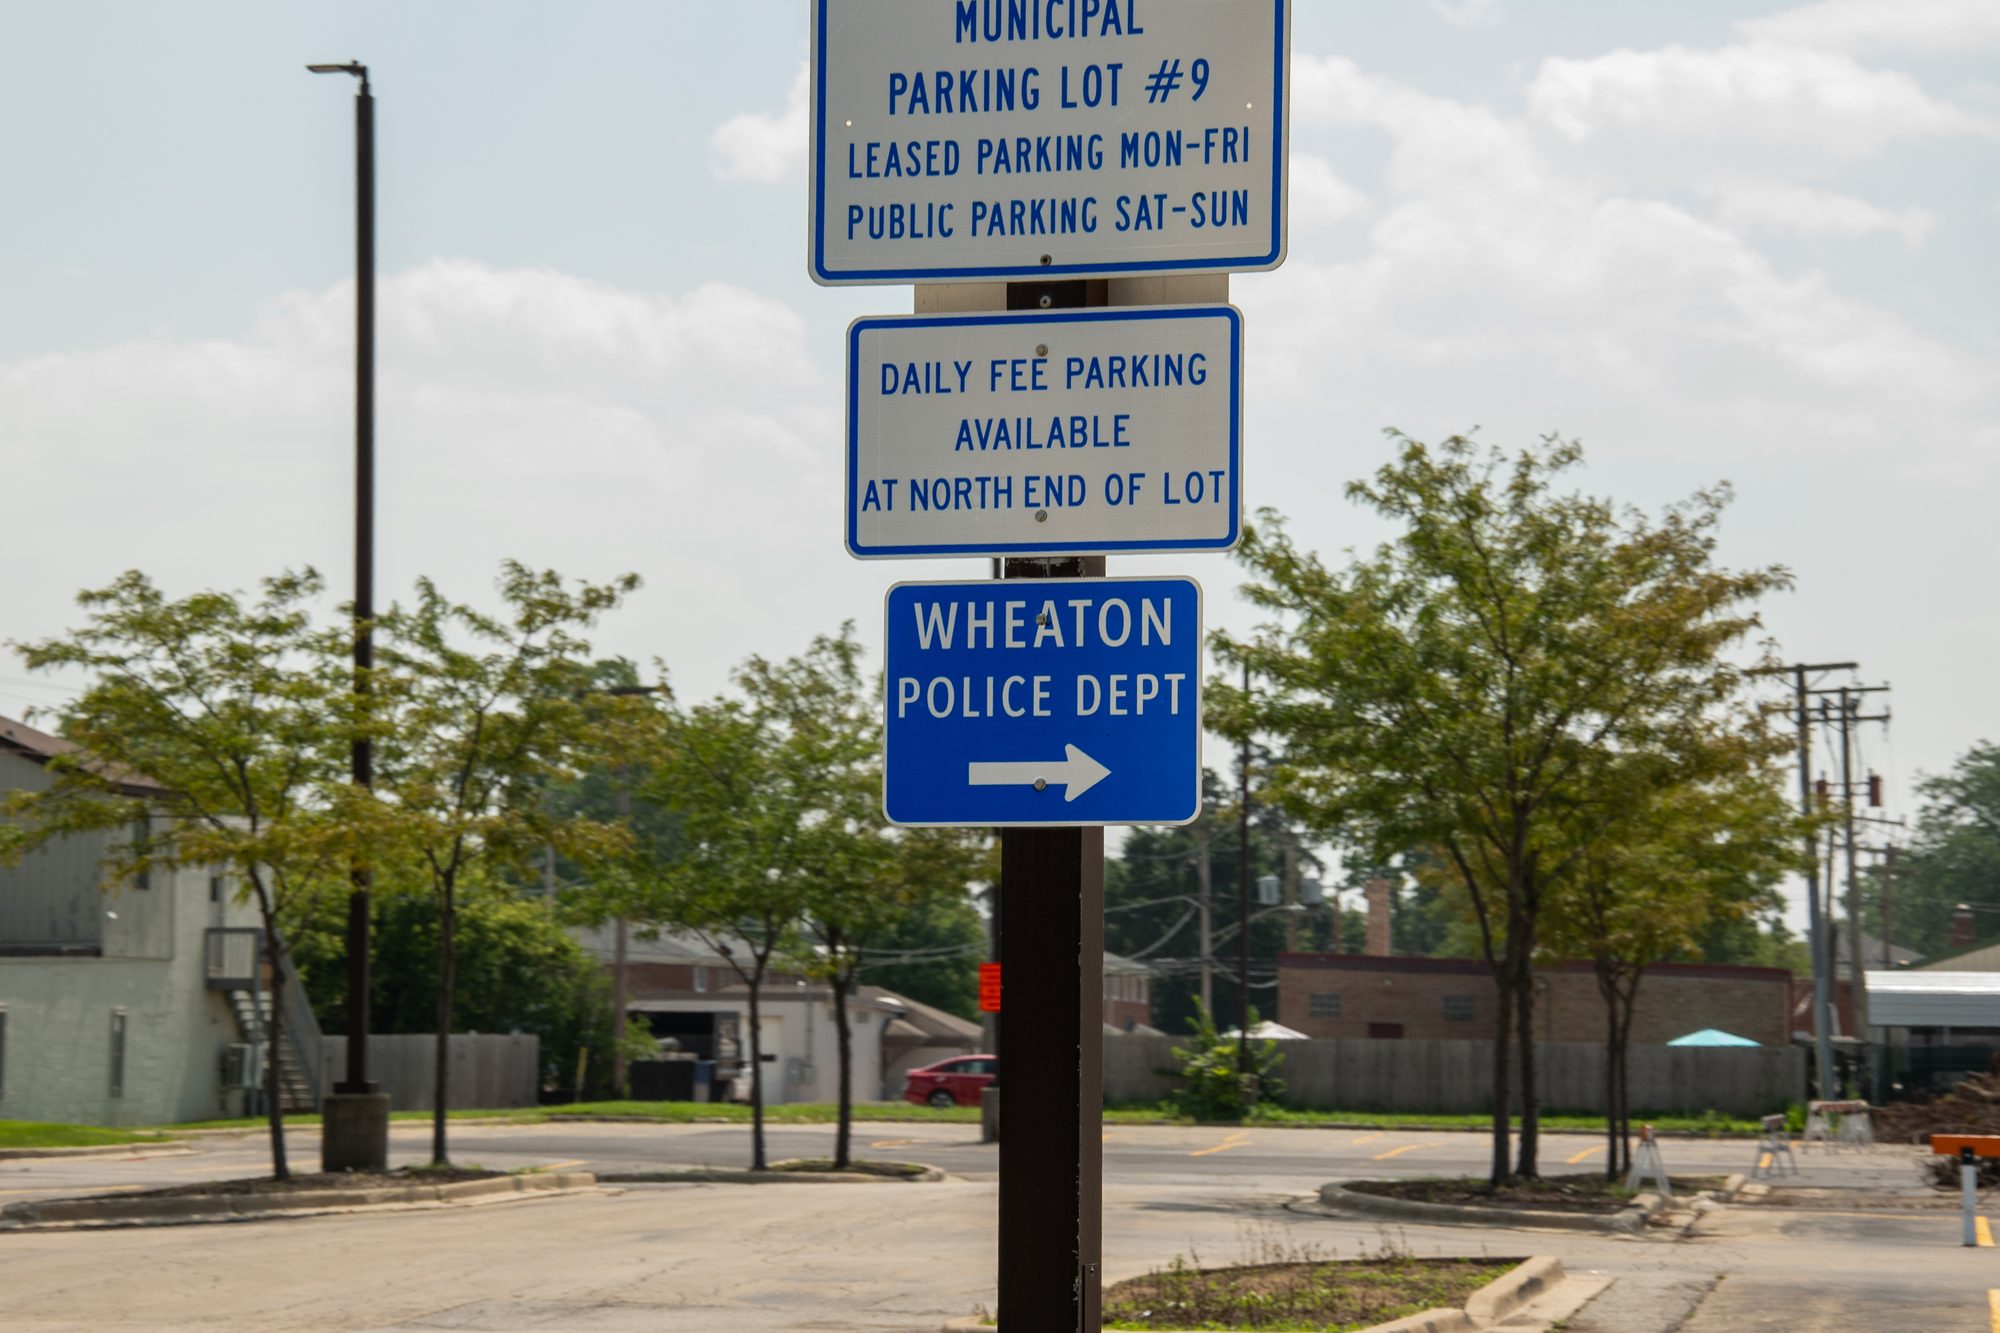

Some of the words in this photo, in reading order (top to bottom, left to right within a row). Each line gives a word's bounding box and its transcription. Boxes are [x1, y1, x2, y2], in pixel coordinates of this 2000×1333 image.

[956, 0, 1143, 43] MUNICIPAL
[889, 68, 1039, 115] PARKING
[1061, 64, 1123, 109] LOT
[1145, 59, 1209, 103] #9
[849, 140, 960, 179] LEASED
[977, 135, 1103, 175] PARKING
[1121, 128, 1248, 168] MON-FRI
[848, 204, 953, 240] PUBLIC
[971, 197, 1097, 237] PARKING
[1116, 191, 1247, 232] SAT-SUN
[881, 362, 971, 395] DAILY
[991, 359, 1048, 392] FEE
[1066, 353, 1206, 389] PARKING
[956, 415, 1129, 451] AVAILABLE
[862, 479, 897, 511] AT
[910, 476, 1012, 512] NORTH
[1024, 475, 1085, 508] END
[1105, 473, 1145, 506] OF
[1164, 470, 1224, 504] LOT
[915, 598, 1170, 649] WHEATON
[899, 676, 1050, 717] POLICE
[1077, 674, 1185, 715] DEPT
